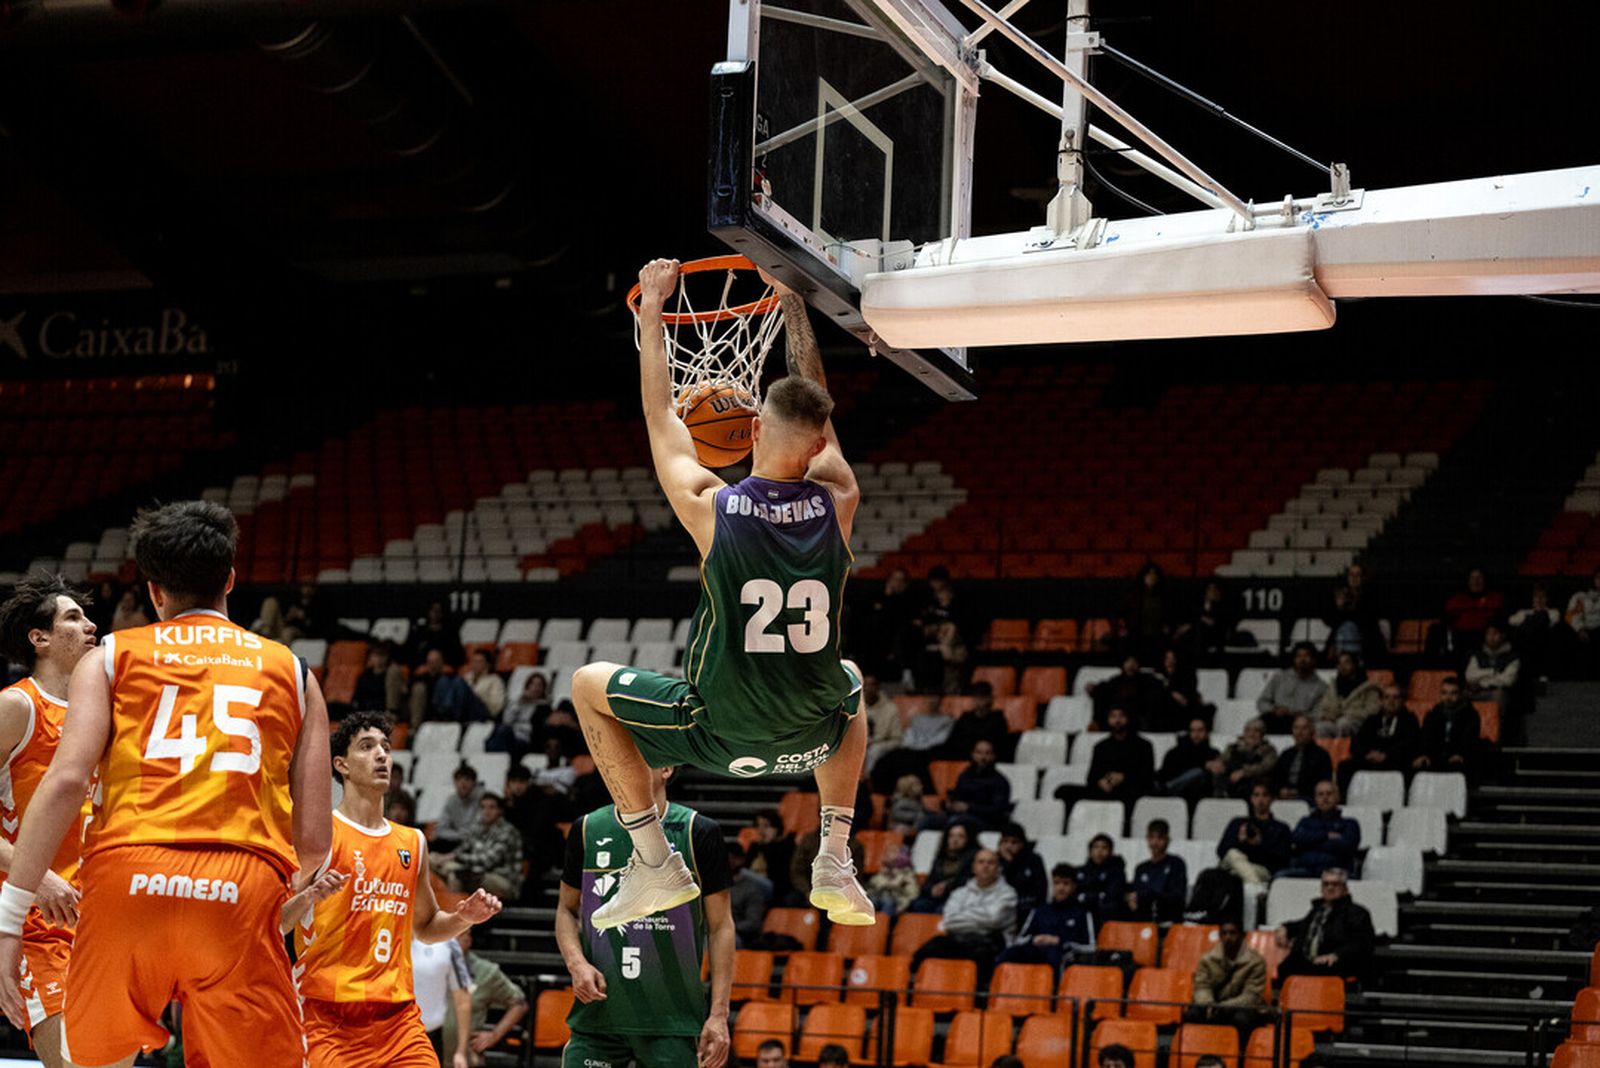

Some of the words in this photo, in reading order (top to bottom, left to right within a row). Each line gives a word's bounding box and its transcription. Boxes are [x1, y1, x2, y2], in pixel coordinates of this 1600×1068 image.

[450, 591, 480, 612] 111
[1241, 588, 1283, 611] 110
[740, 578, 830, 654] 23
[154, 625, 263, 649] KURFIS
[183, 653, 254, 668] CaixaBank
[144, 683, 264, 775] 45
[776, 743, 830, 763] COSTA
[129, 873, 239, 905] PAMESA
[374, 928, 392, 963] 8
[622, 946, 641, 980] 5
